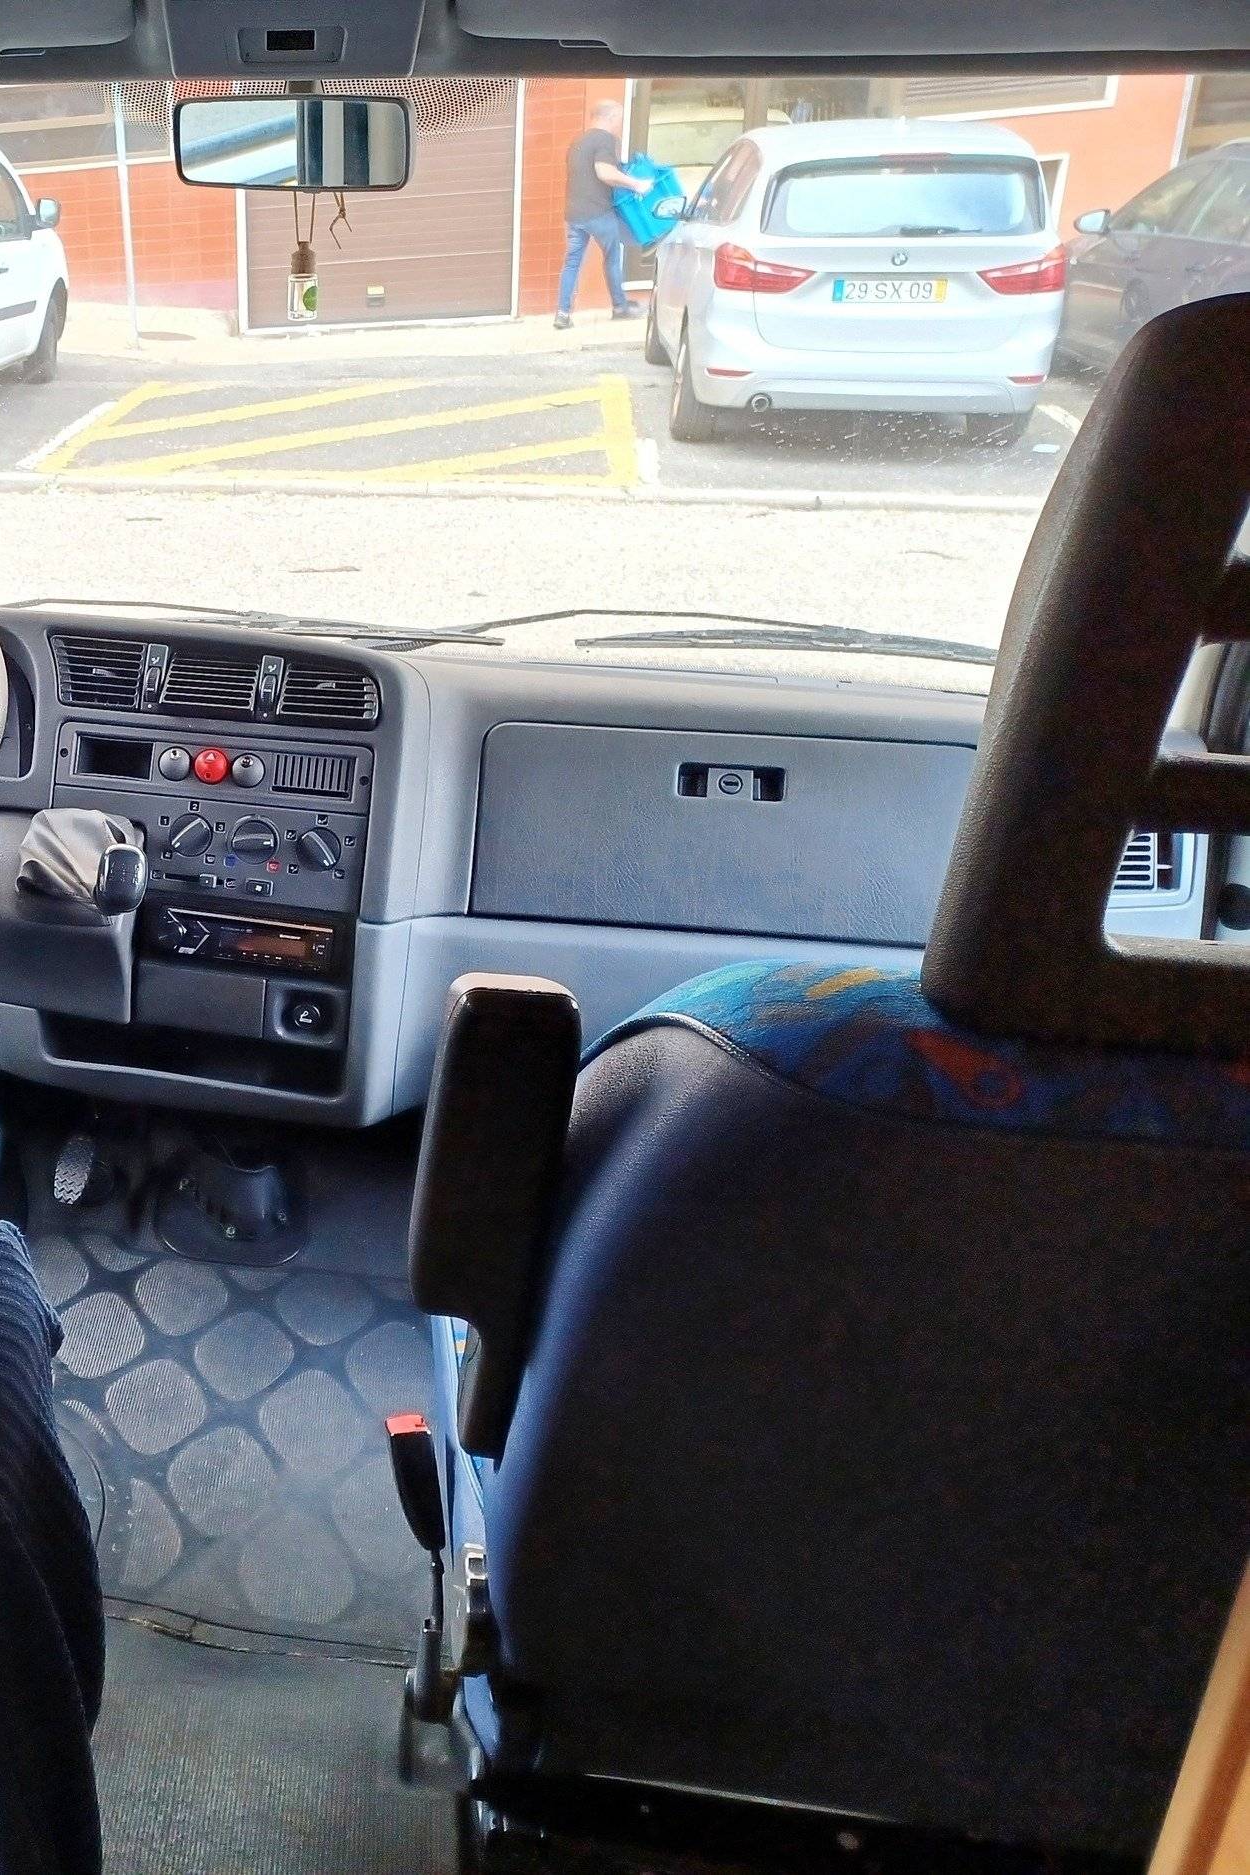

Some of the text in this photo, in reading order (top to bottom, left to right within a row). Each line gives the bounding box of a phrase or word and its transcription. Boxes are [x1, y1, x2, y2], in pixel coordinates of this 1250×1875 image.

[845, 282, 934, 300] 29 SX 09
